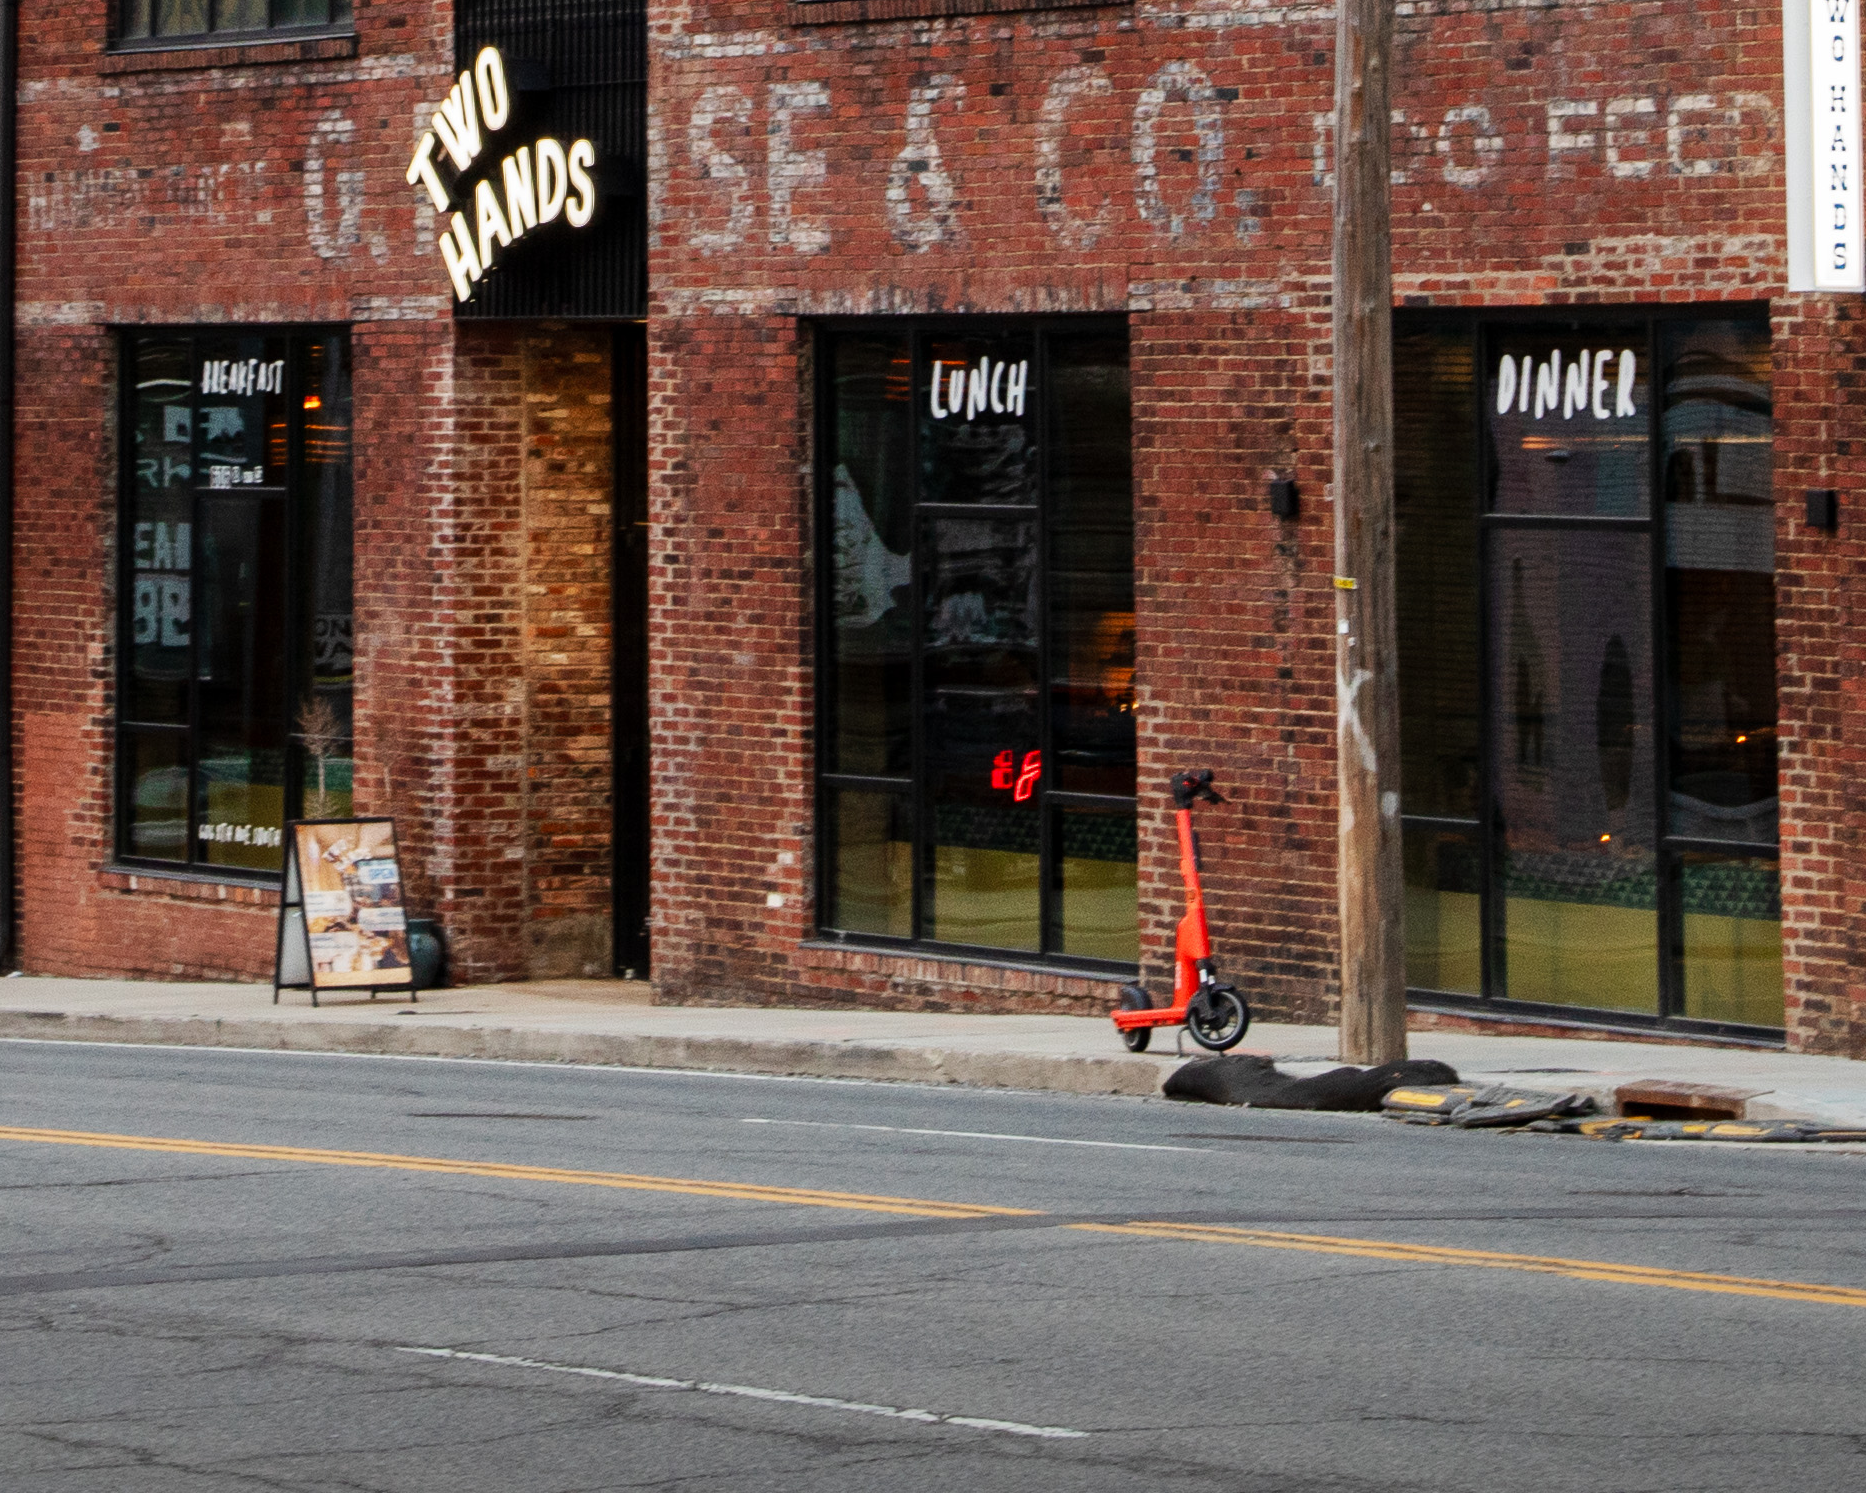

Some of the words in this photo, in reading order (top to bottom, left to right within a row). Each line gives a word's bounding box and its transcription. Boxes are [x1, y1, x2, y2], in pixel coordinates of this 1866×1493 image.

[406, 46, 510, 213] TWO
[1830, 85, 1847, 270] HANDS
[439, 138, 595, 303] HANDS
[931, 357, 1029, 420] LUNCH
[1497, 349, 1636, 420] DINNER
